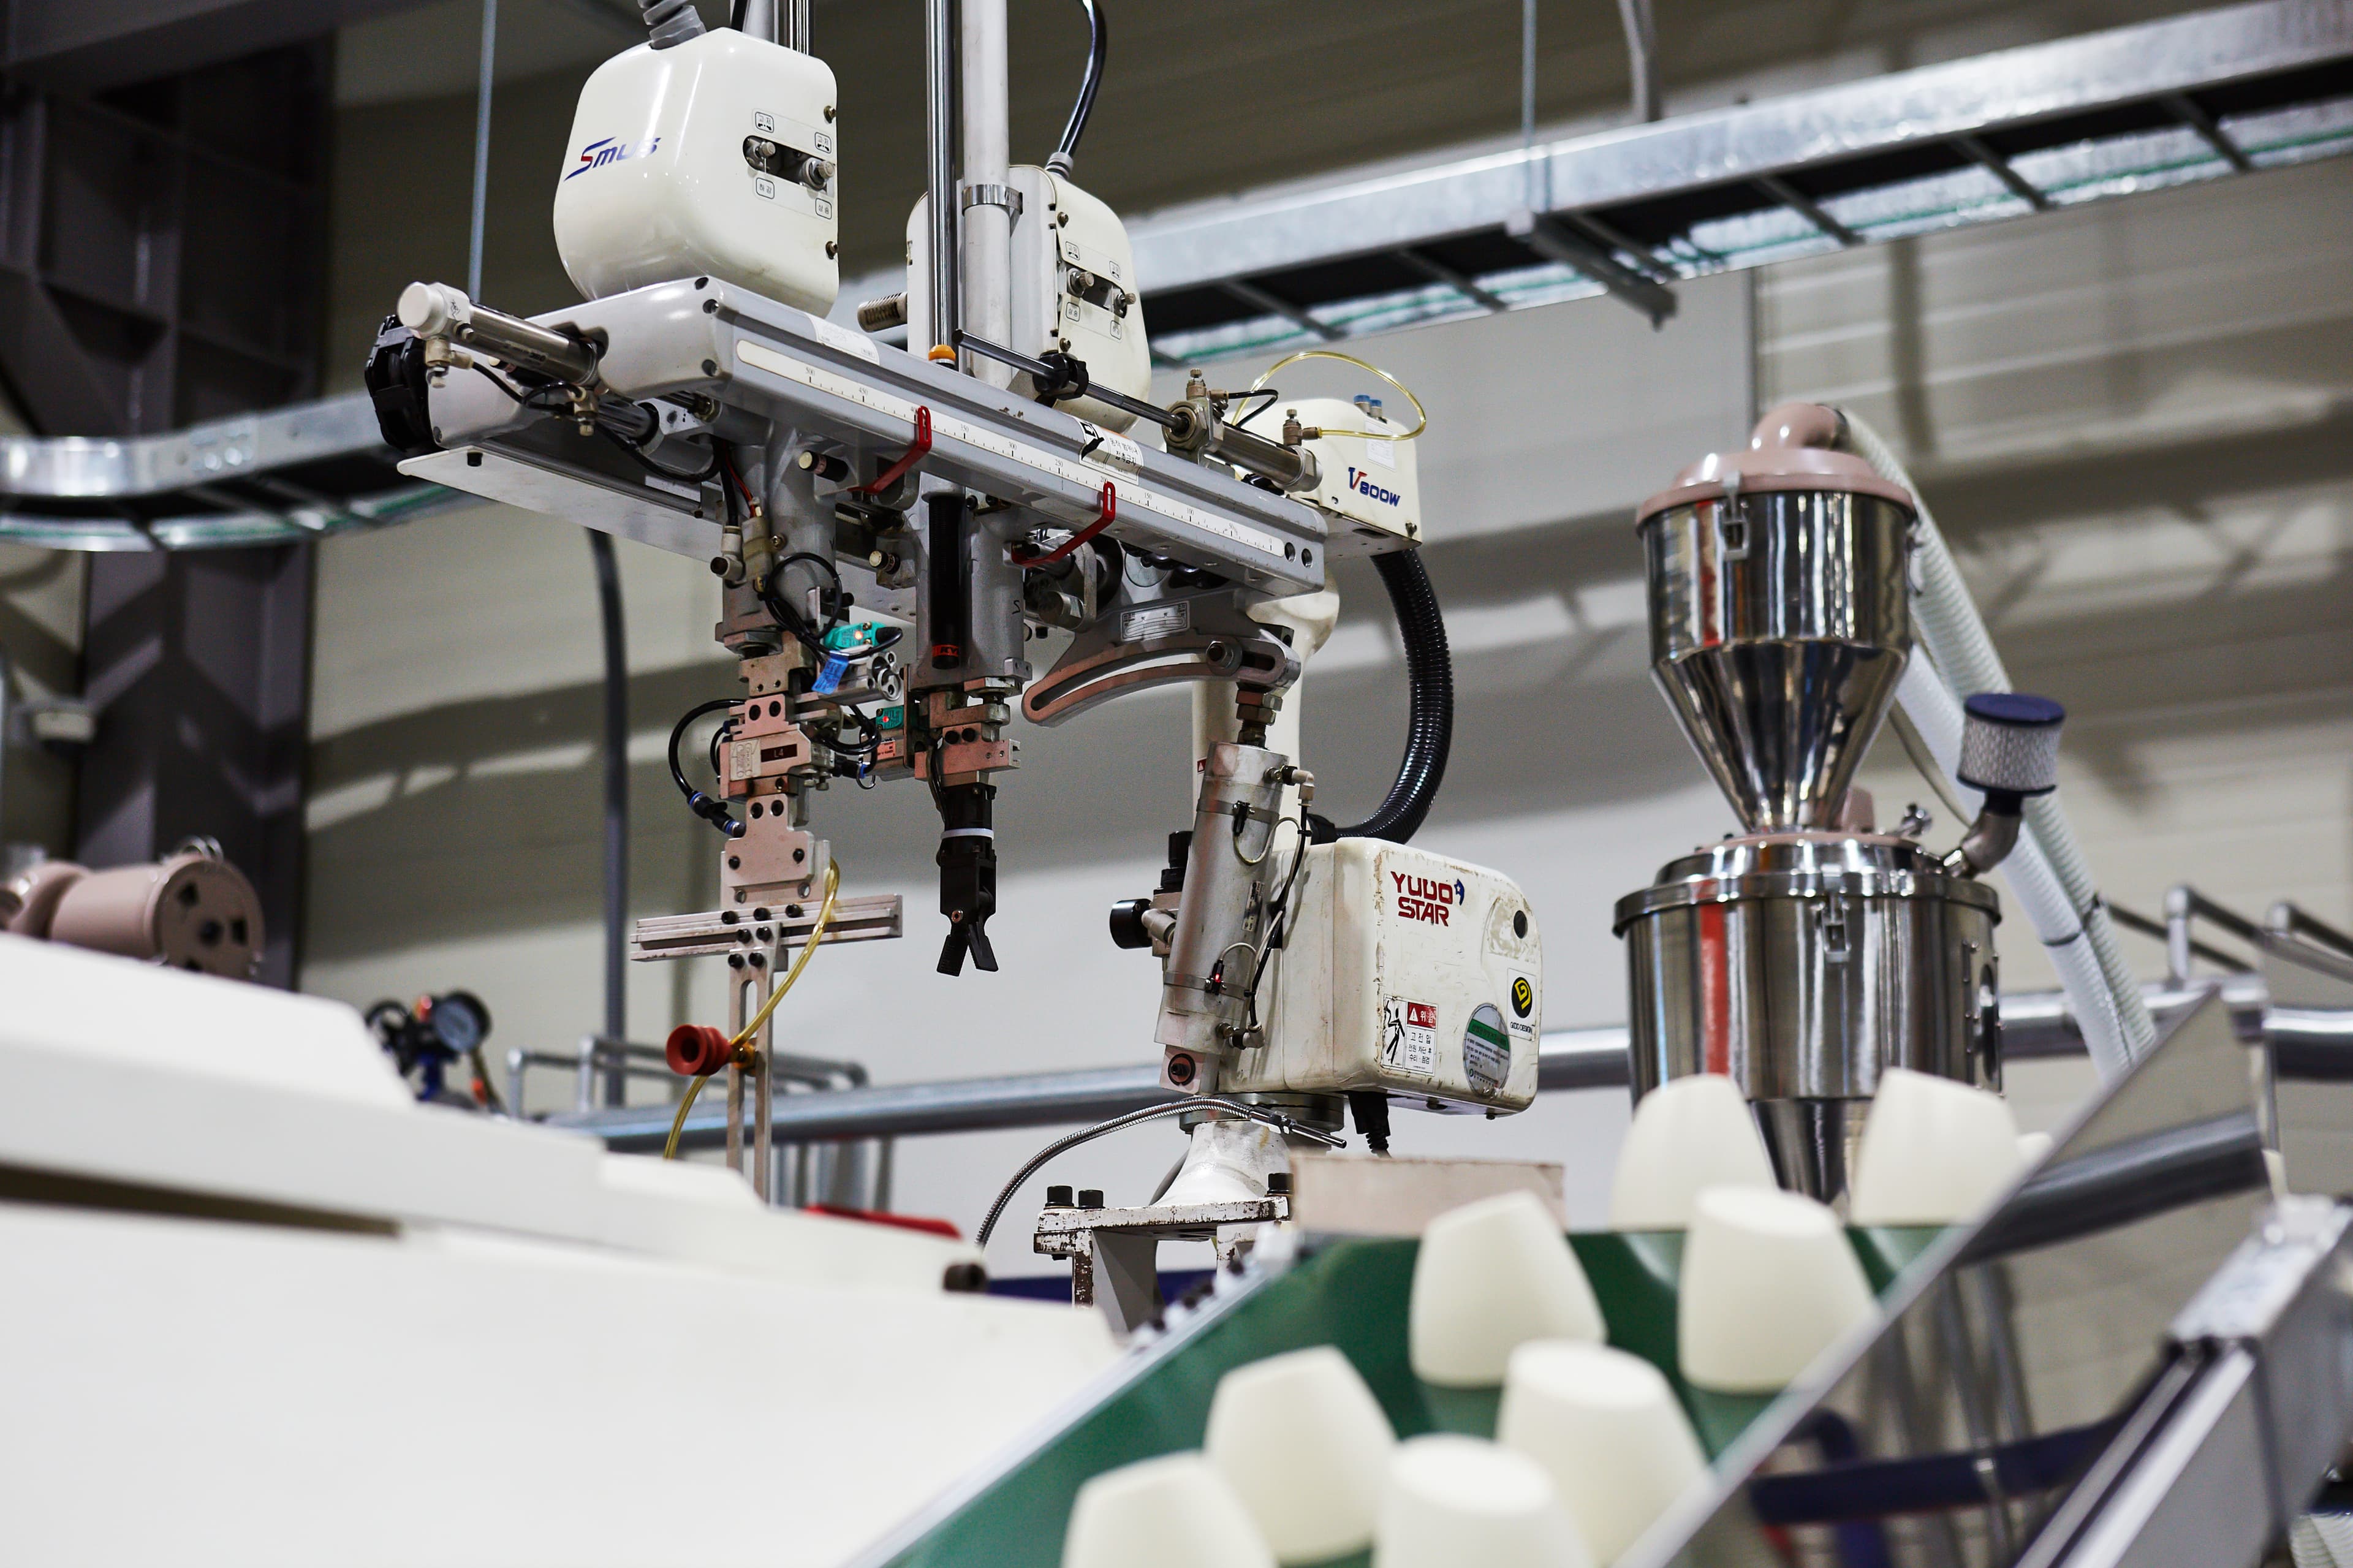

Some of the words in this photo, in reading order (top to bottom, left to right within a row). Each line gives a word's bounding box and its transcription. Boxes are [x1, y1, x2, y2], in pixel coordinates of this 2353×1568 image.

[1055, 459, 1064, 468] 250
[774, 748, 784, 758] L4
[1390, 871, 1453, 904] YUDO
[1398, 896, 1449, 926] STAR
